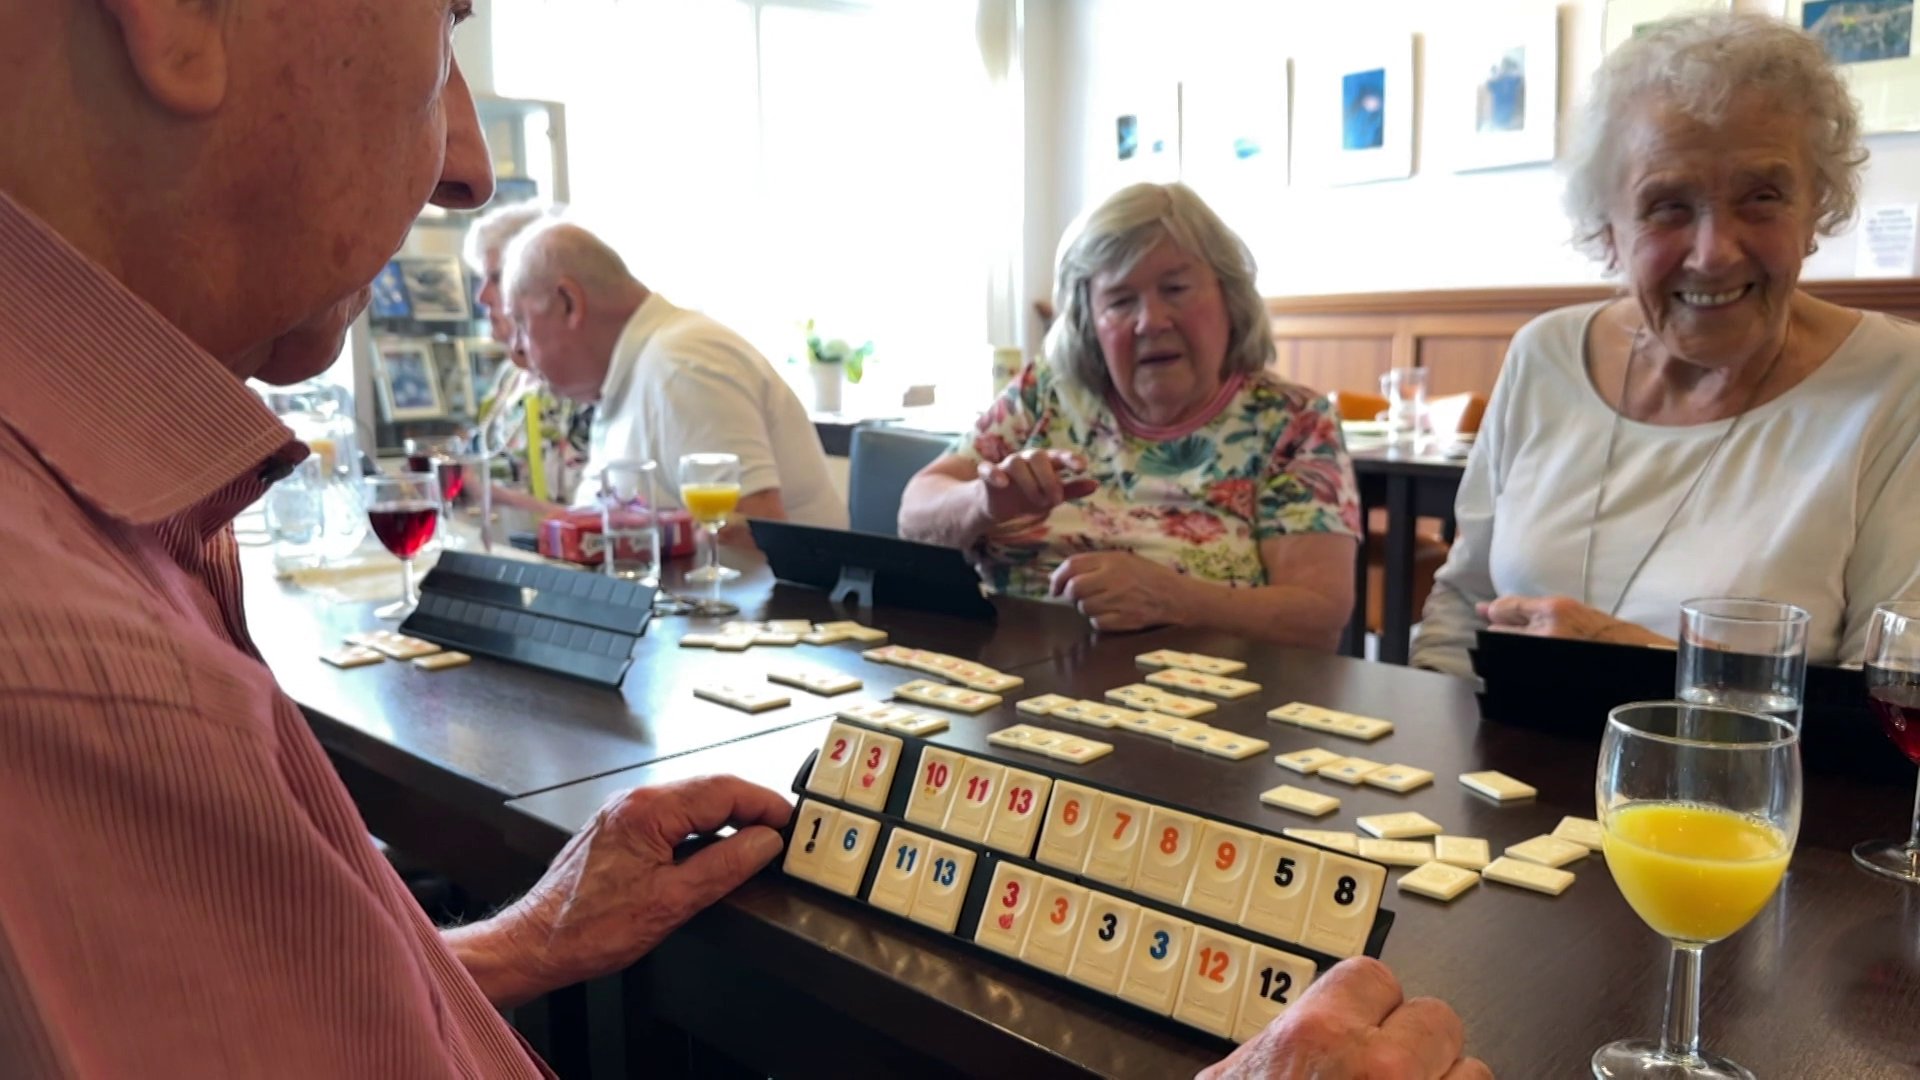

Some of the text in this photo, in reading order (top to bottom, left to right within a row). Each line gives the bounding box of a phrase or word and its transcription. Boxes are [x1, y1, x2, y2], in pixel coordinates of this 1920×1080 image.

[831, 739, 883, 770] 2 3
[926, 762, 1034, 814] 10 11 13
[812, 817, 858, 851] 1 6
[1063, 799, 1357, 906] 6 7 8 9 5 8
[897, 845, 957, 886] 11 13
[1002, 880, 1292, 1005] 3 3 3 3 12 12
